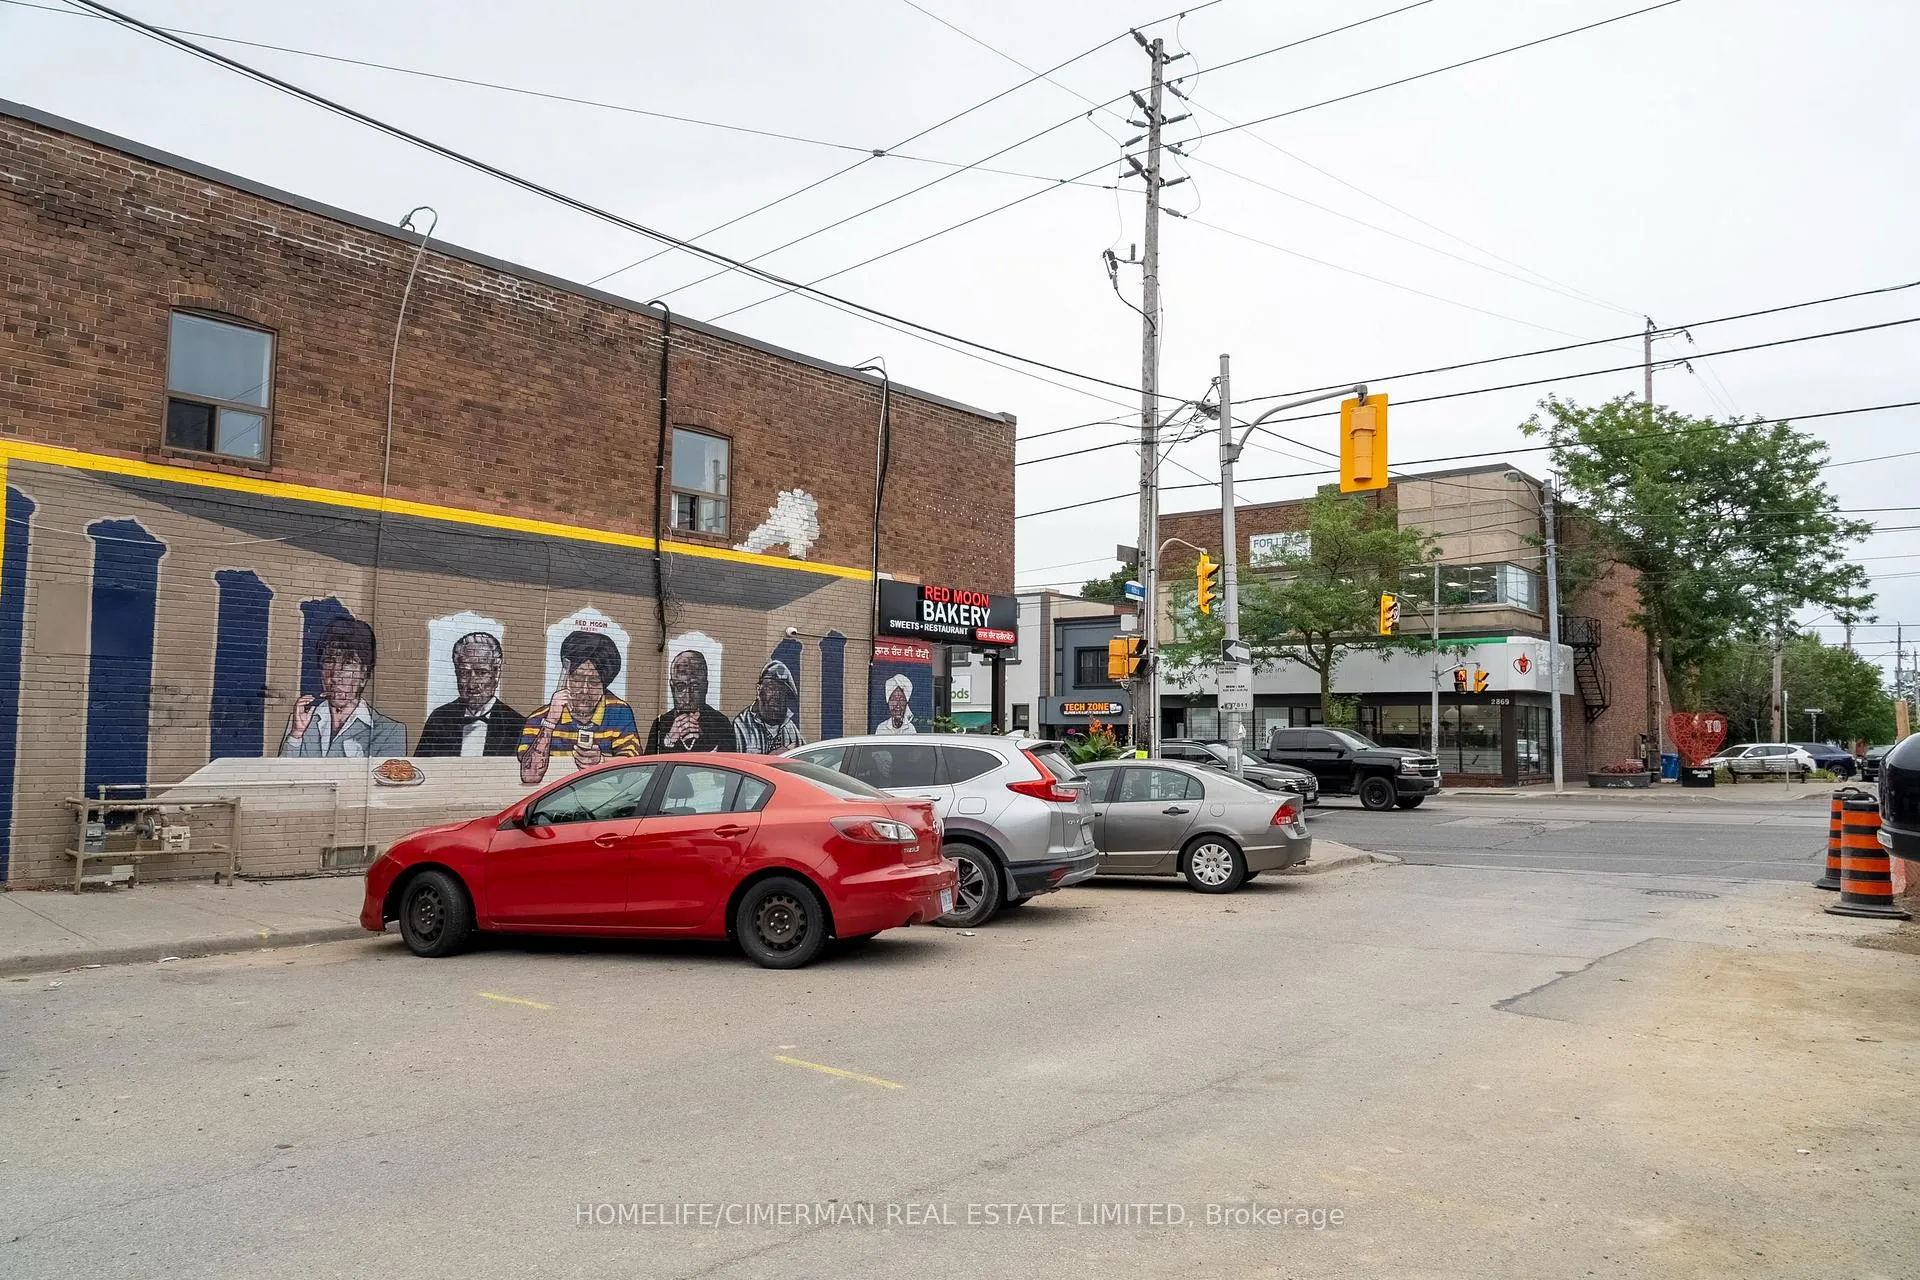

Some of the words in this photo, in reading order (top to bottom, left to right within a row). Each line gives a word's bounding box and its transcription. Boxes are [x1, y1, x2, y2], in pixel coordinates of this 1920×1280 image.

[1253, 538, 1273, 548] FOR
[925, 585, 950, 602] RED
[953, 589, 990, 608] MOON
[923, 600, 991, 627] BAKERY
[889, 619, 920, 631] SWEETS
[924, 623, 968, 635] RESTAURANT
[1064, 703, 1086, 712] TECH
[1087, 703, 1109, 711] ZONE
